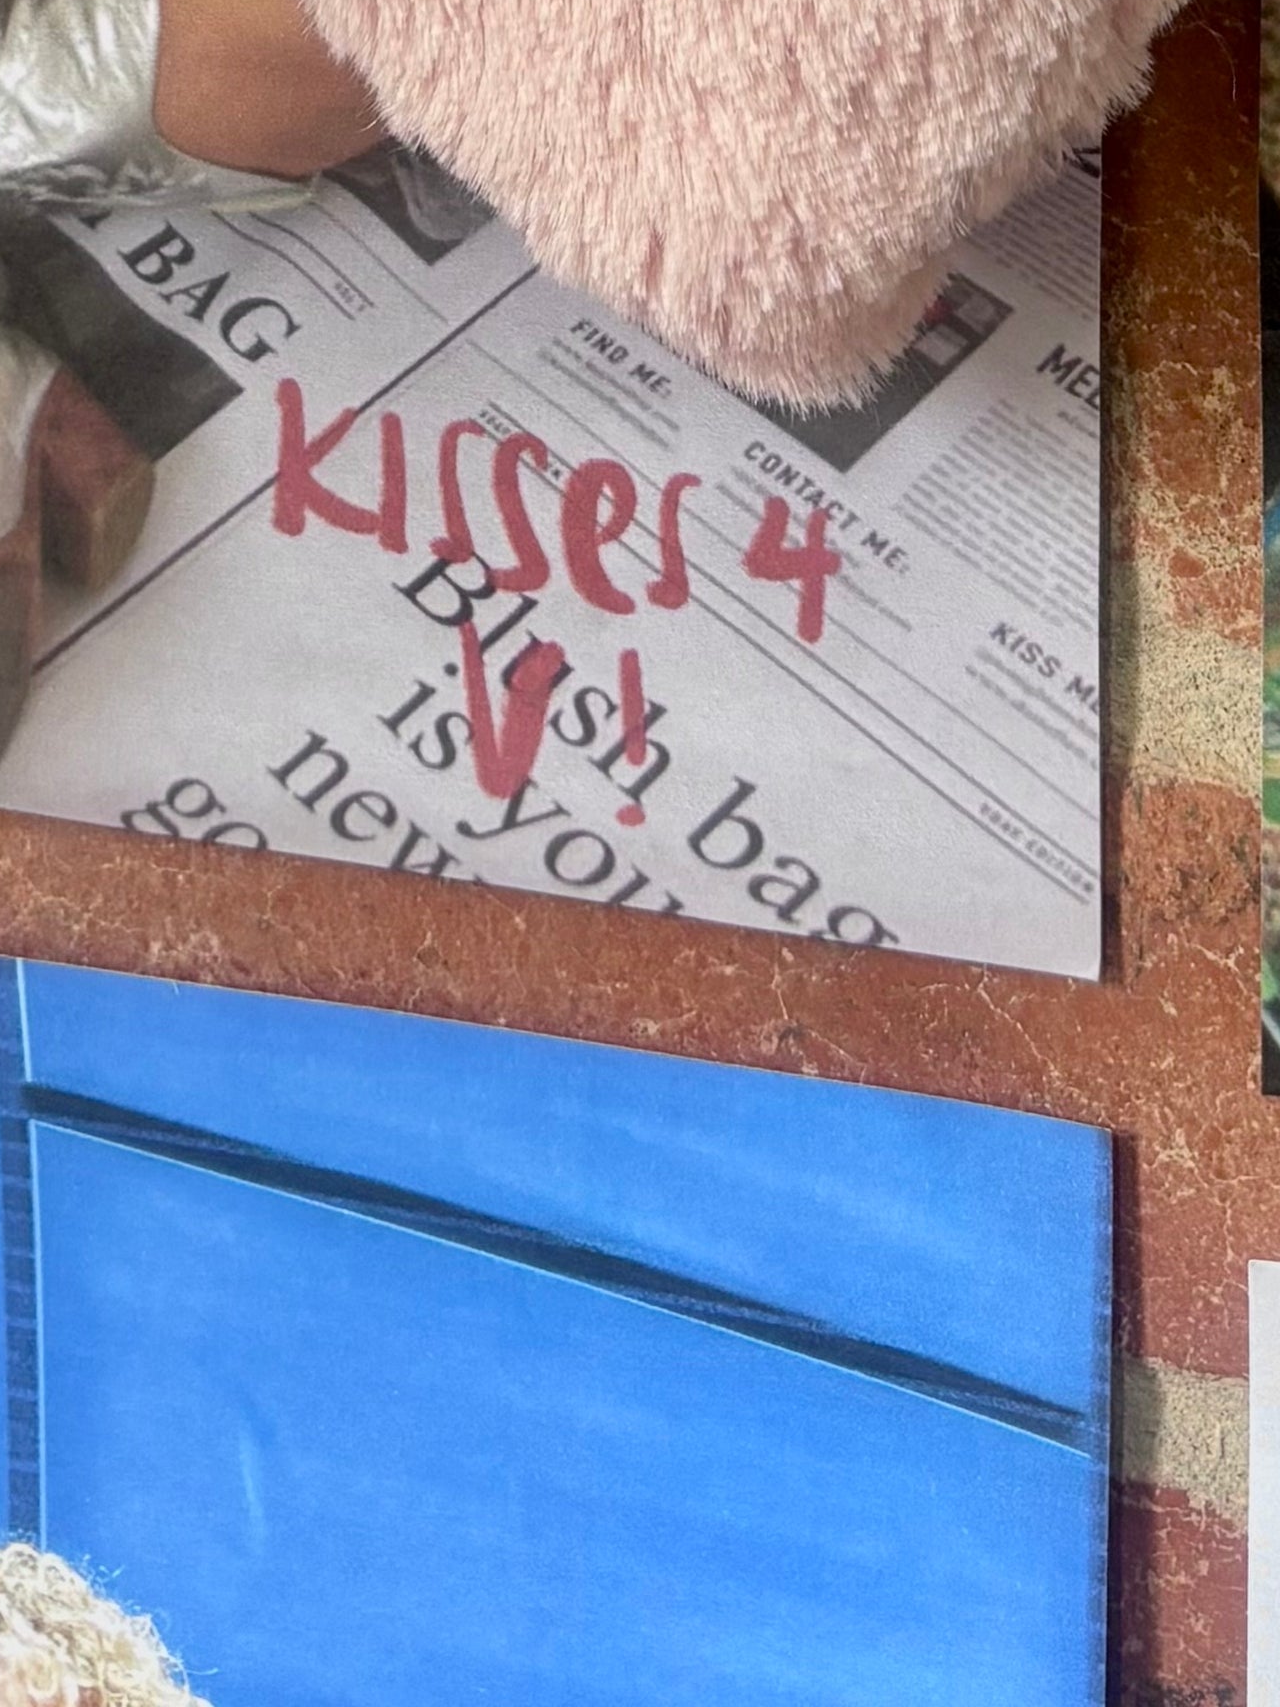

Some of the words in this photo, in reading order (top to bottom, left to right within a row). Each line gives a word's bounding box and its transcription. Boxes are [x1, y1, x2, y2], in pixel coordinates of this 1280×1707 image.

[118, 222, 301, 365] BAG
[570, 318, 628, 370] FIND
[739, 493, 843, 646] 4
[988, 621, 1063, 680] KISS
[377, 659, 476, 772] is
